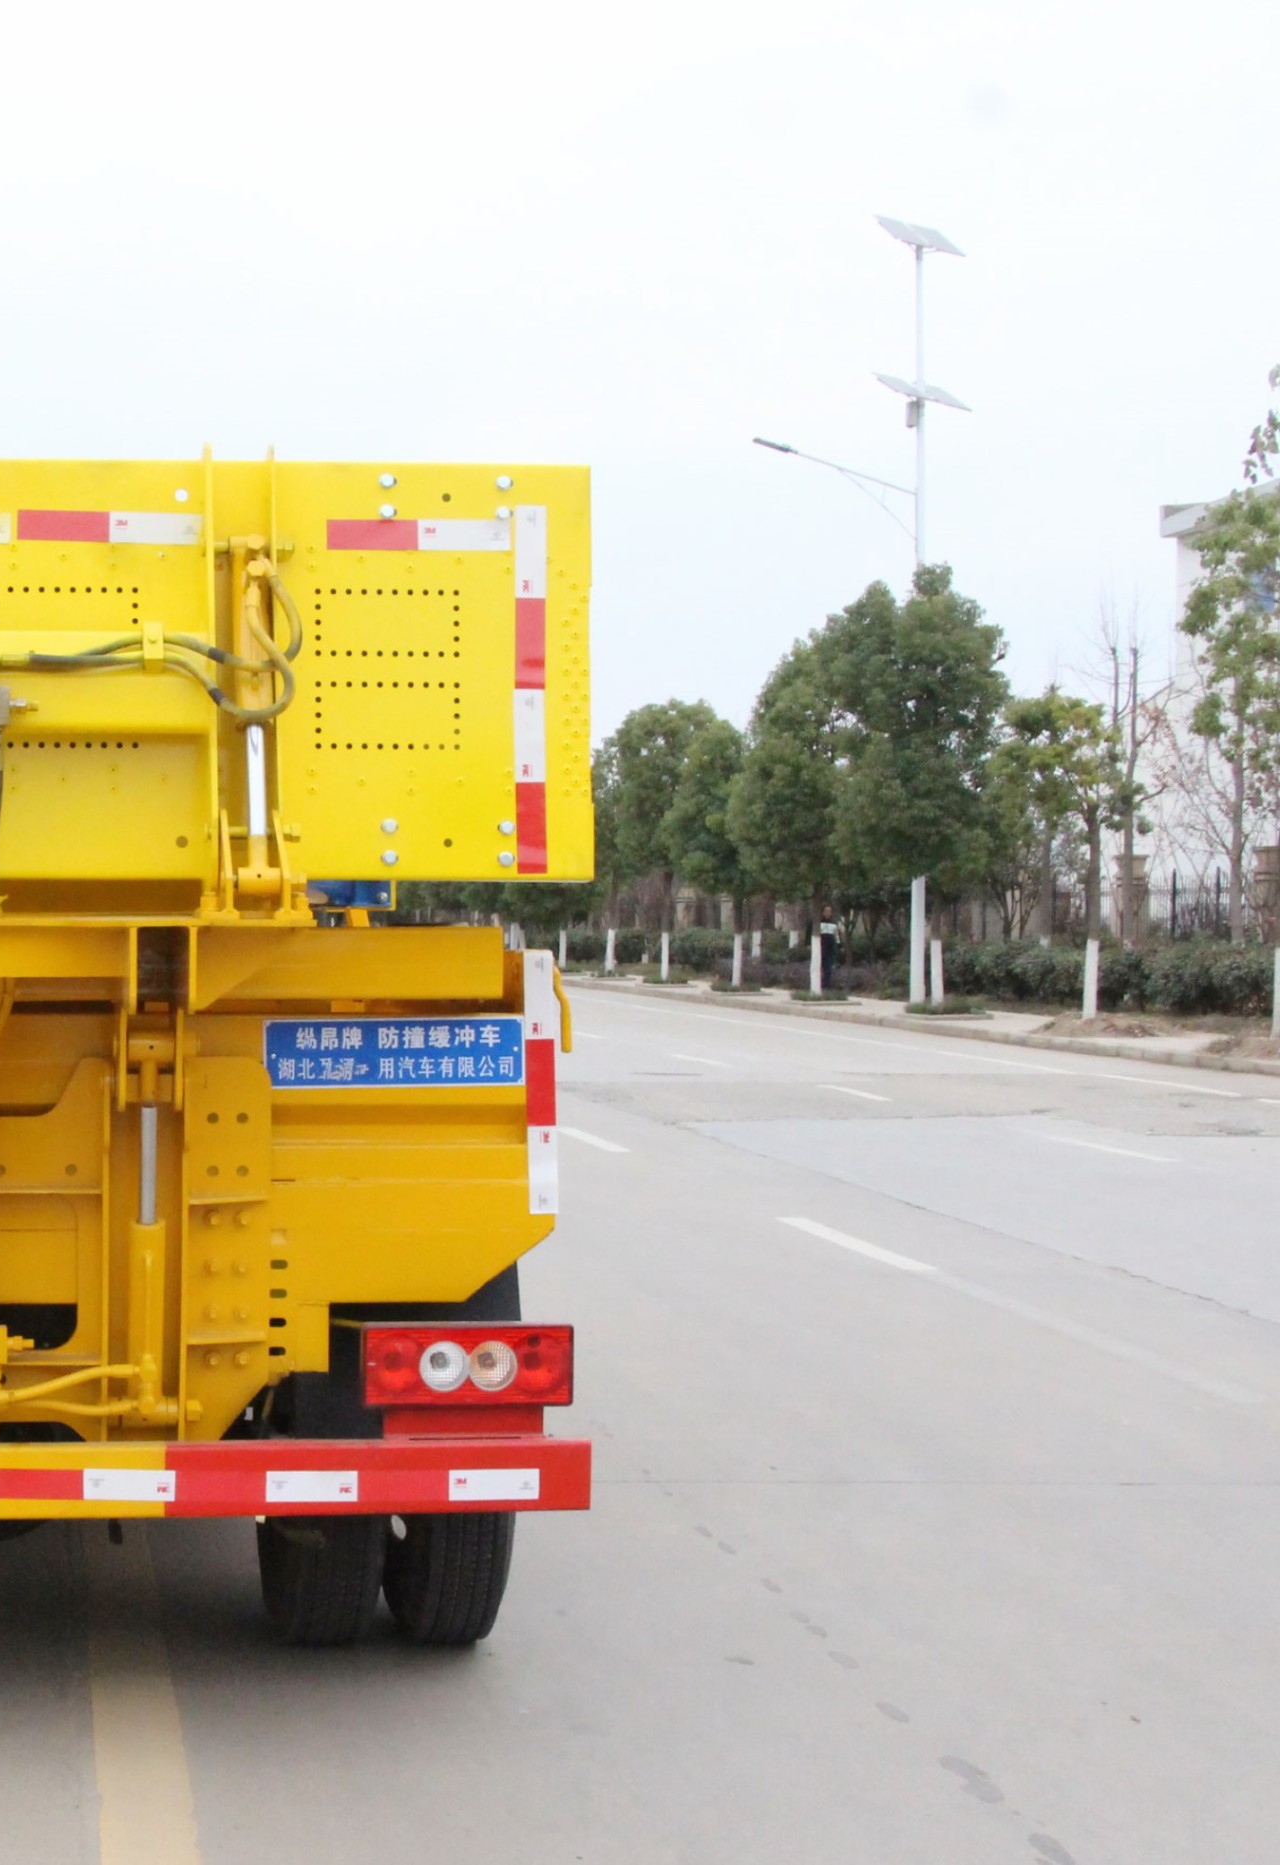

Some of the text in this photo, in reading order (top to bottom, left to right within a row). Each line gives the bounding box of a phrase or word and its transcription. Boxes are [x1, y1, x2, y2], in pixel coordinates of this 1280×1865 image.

[377, 1024, 501, 1051] 防撞缓冲车
[277, 1055, 515, 1081] 湖北用汽车有限公司
